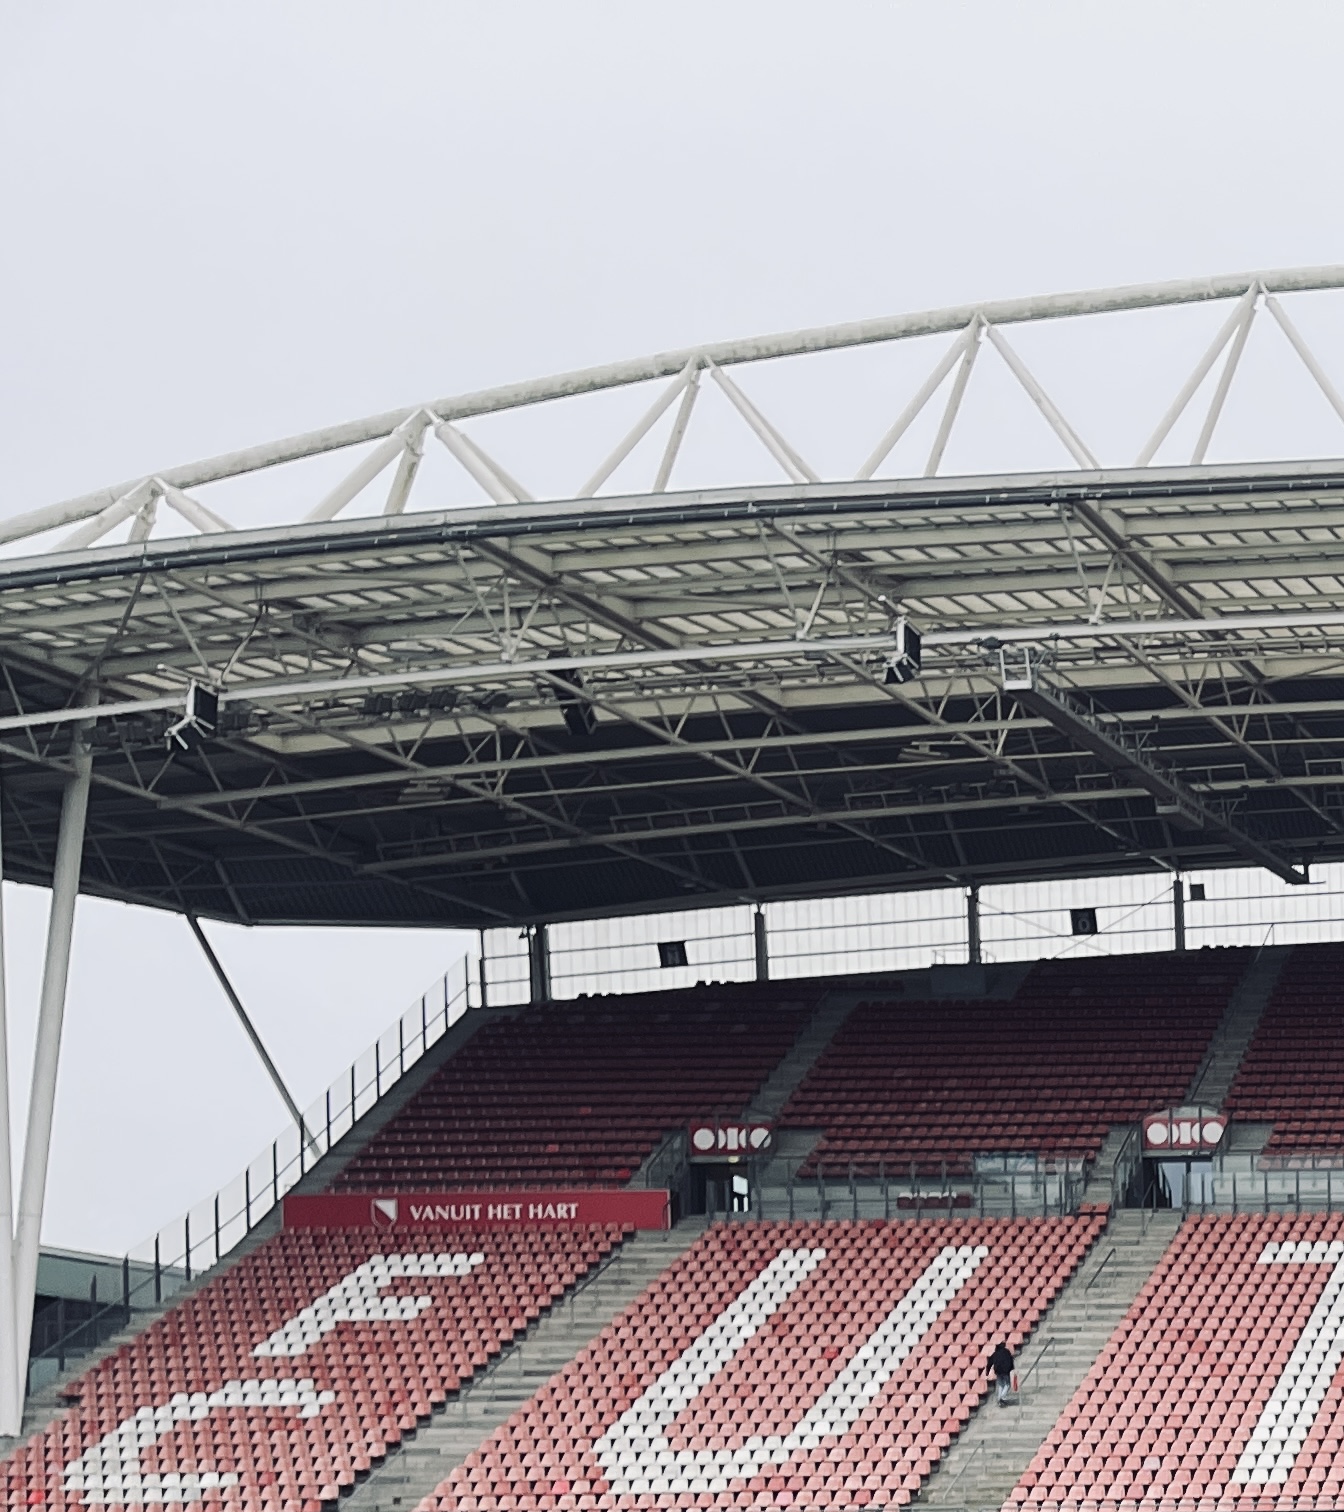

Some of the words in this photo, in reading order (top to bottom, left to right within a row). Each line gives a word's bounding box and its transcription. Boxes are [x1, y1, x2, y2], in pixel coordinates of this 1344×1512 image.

[409, 1203, 483, 1222] VANUIT
[487, 1203, 523, 1221] HET
[528, 1202, 579, 1220] HART
